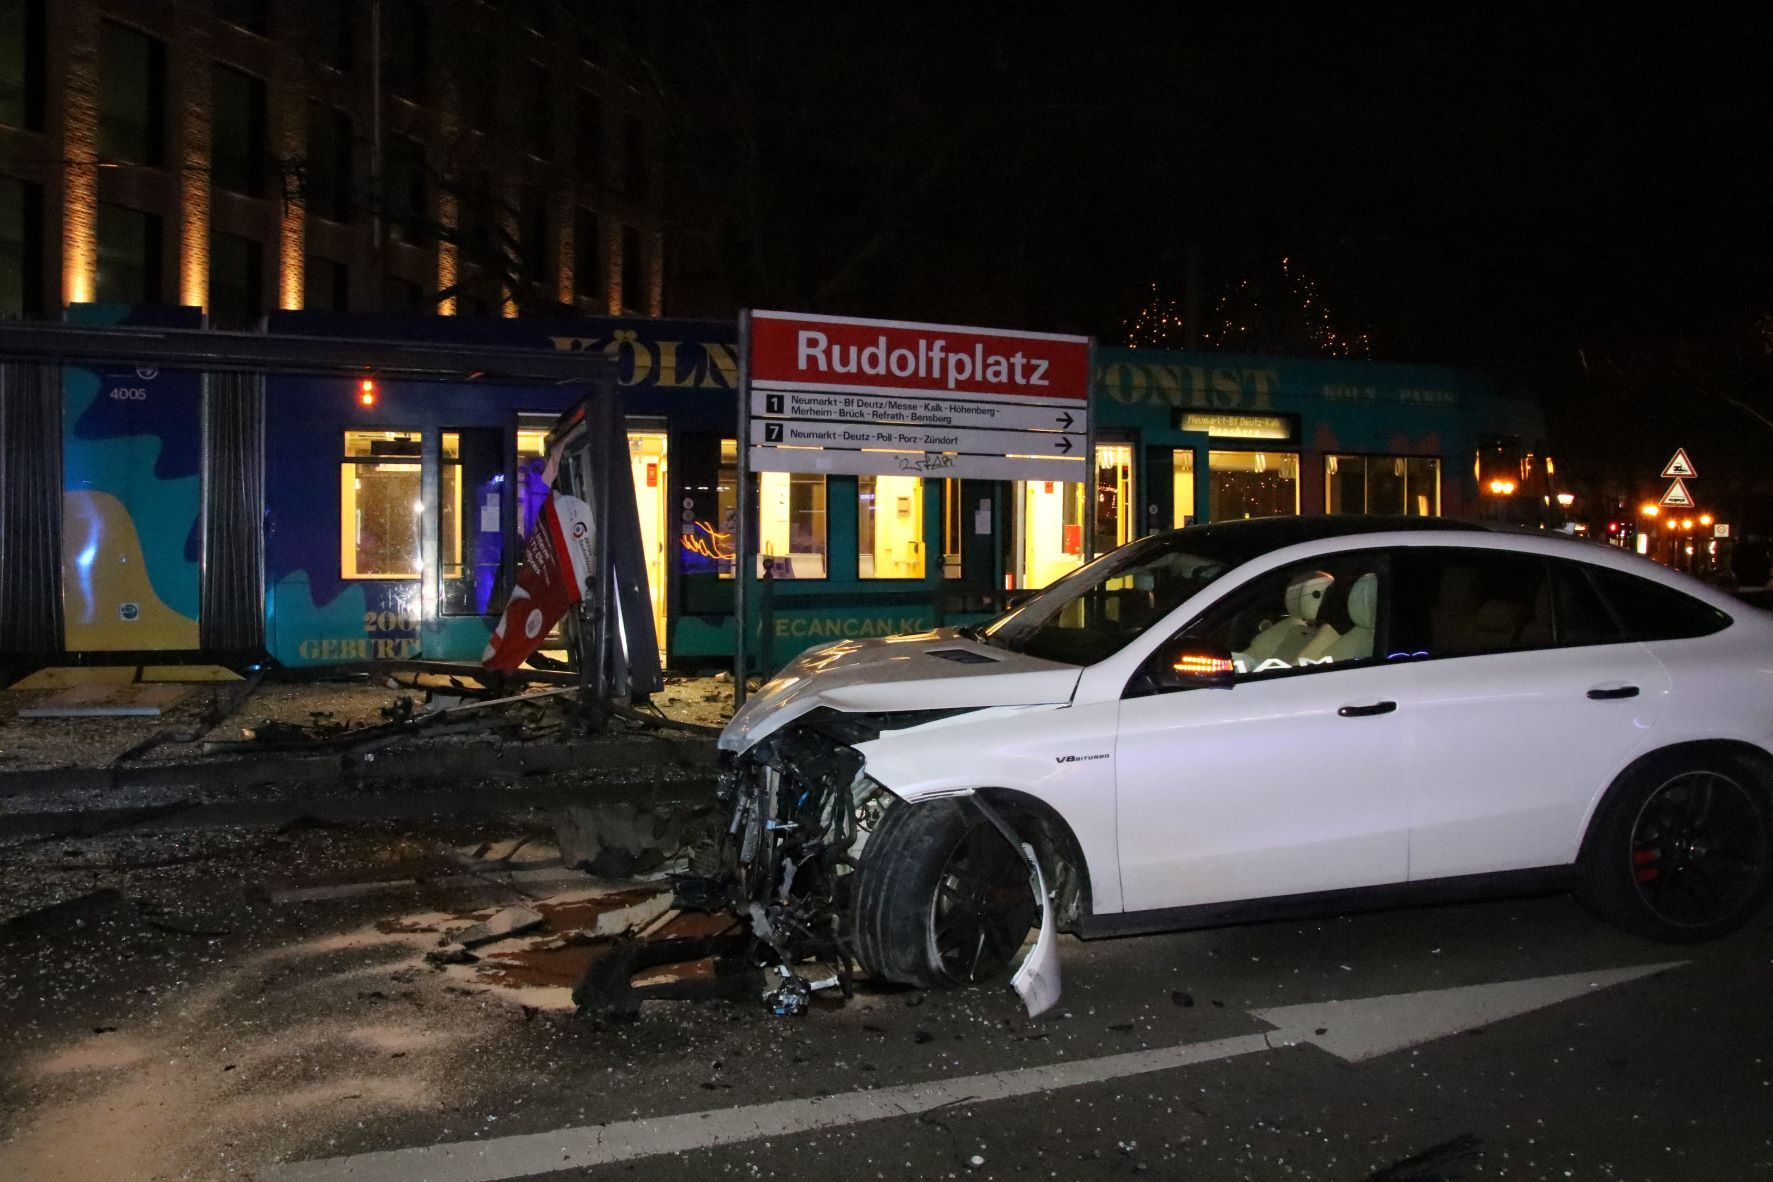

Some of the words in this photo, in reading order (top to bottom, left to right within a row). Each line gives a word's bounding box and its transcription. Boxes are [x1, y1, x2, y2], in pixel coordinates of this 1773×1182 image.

[797, 330, 1050, 389] Rudolfplatz
[109, 388, 147, 400] 4005
[1097, 362, 1281, 410] ONIST
[791, 395, 838, 407] Neumarkt
[844, 398, 854, 407] Bf
[924, 402, 943, 412] Kalk
[791, 406, 832, 416] Merheim
[872, 410, 905, 420] Refrath
[911, 412, 952, 424] Bensberg
[769, 425, 779, 439] 7
[790, 428, 837, 440] Neumarkt
[843, 431, 870, 441] Deutz
[877, 432, 892, 442] Poll
[898, 433, 917, 444] Porz
